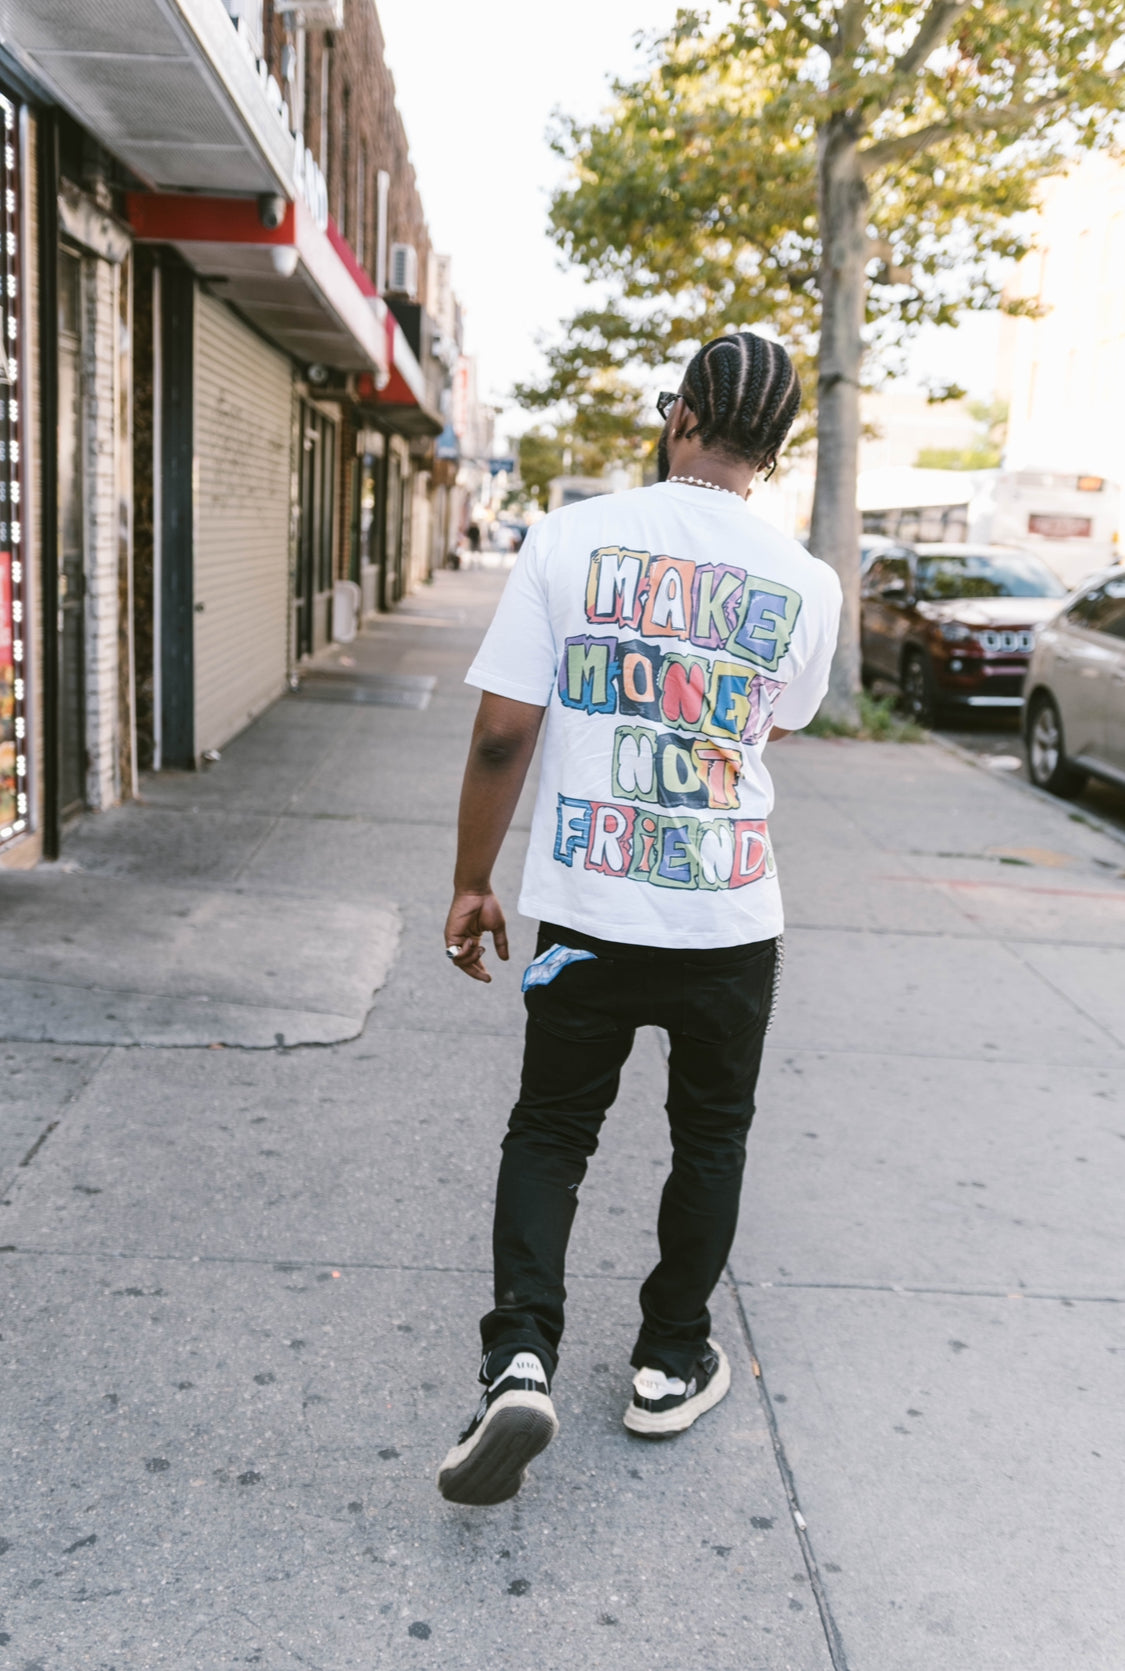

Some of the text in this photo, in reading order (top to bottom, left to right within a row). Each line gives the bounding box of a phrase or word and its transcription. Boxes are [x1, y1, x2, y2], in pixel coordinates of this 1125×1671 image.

[588, 549, 797, 667] MAKE
[561, 638, 784, 740] MONEY
[613, 728, 741, 806] NOT
